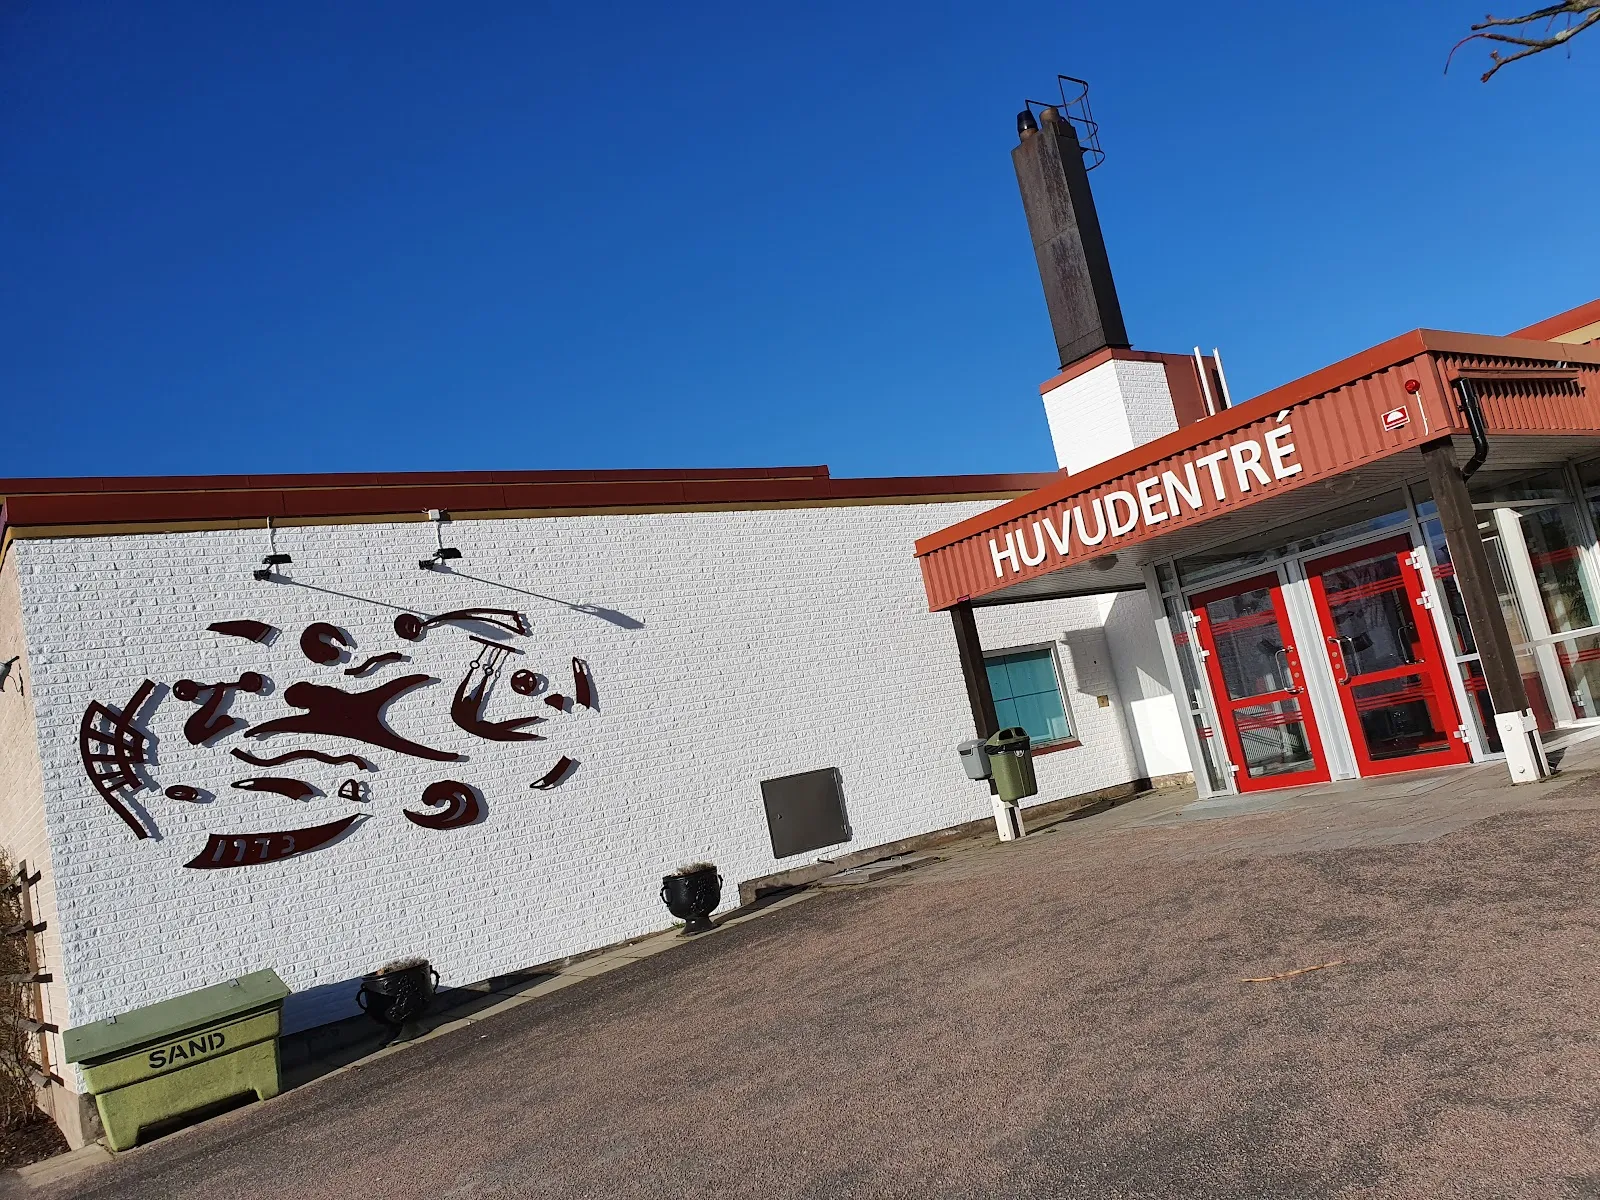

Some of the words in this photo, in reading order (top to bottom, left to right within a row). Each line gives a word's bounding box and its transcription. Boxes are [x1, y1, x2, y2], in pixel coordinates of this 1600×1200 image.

[988, 409, 1303, 578] HUVUDENTRÉ
[211, 835, 296, 862] 1973
[149, 1032, 225, 1069] SAND
